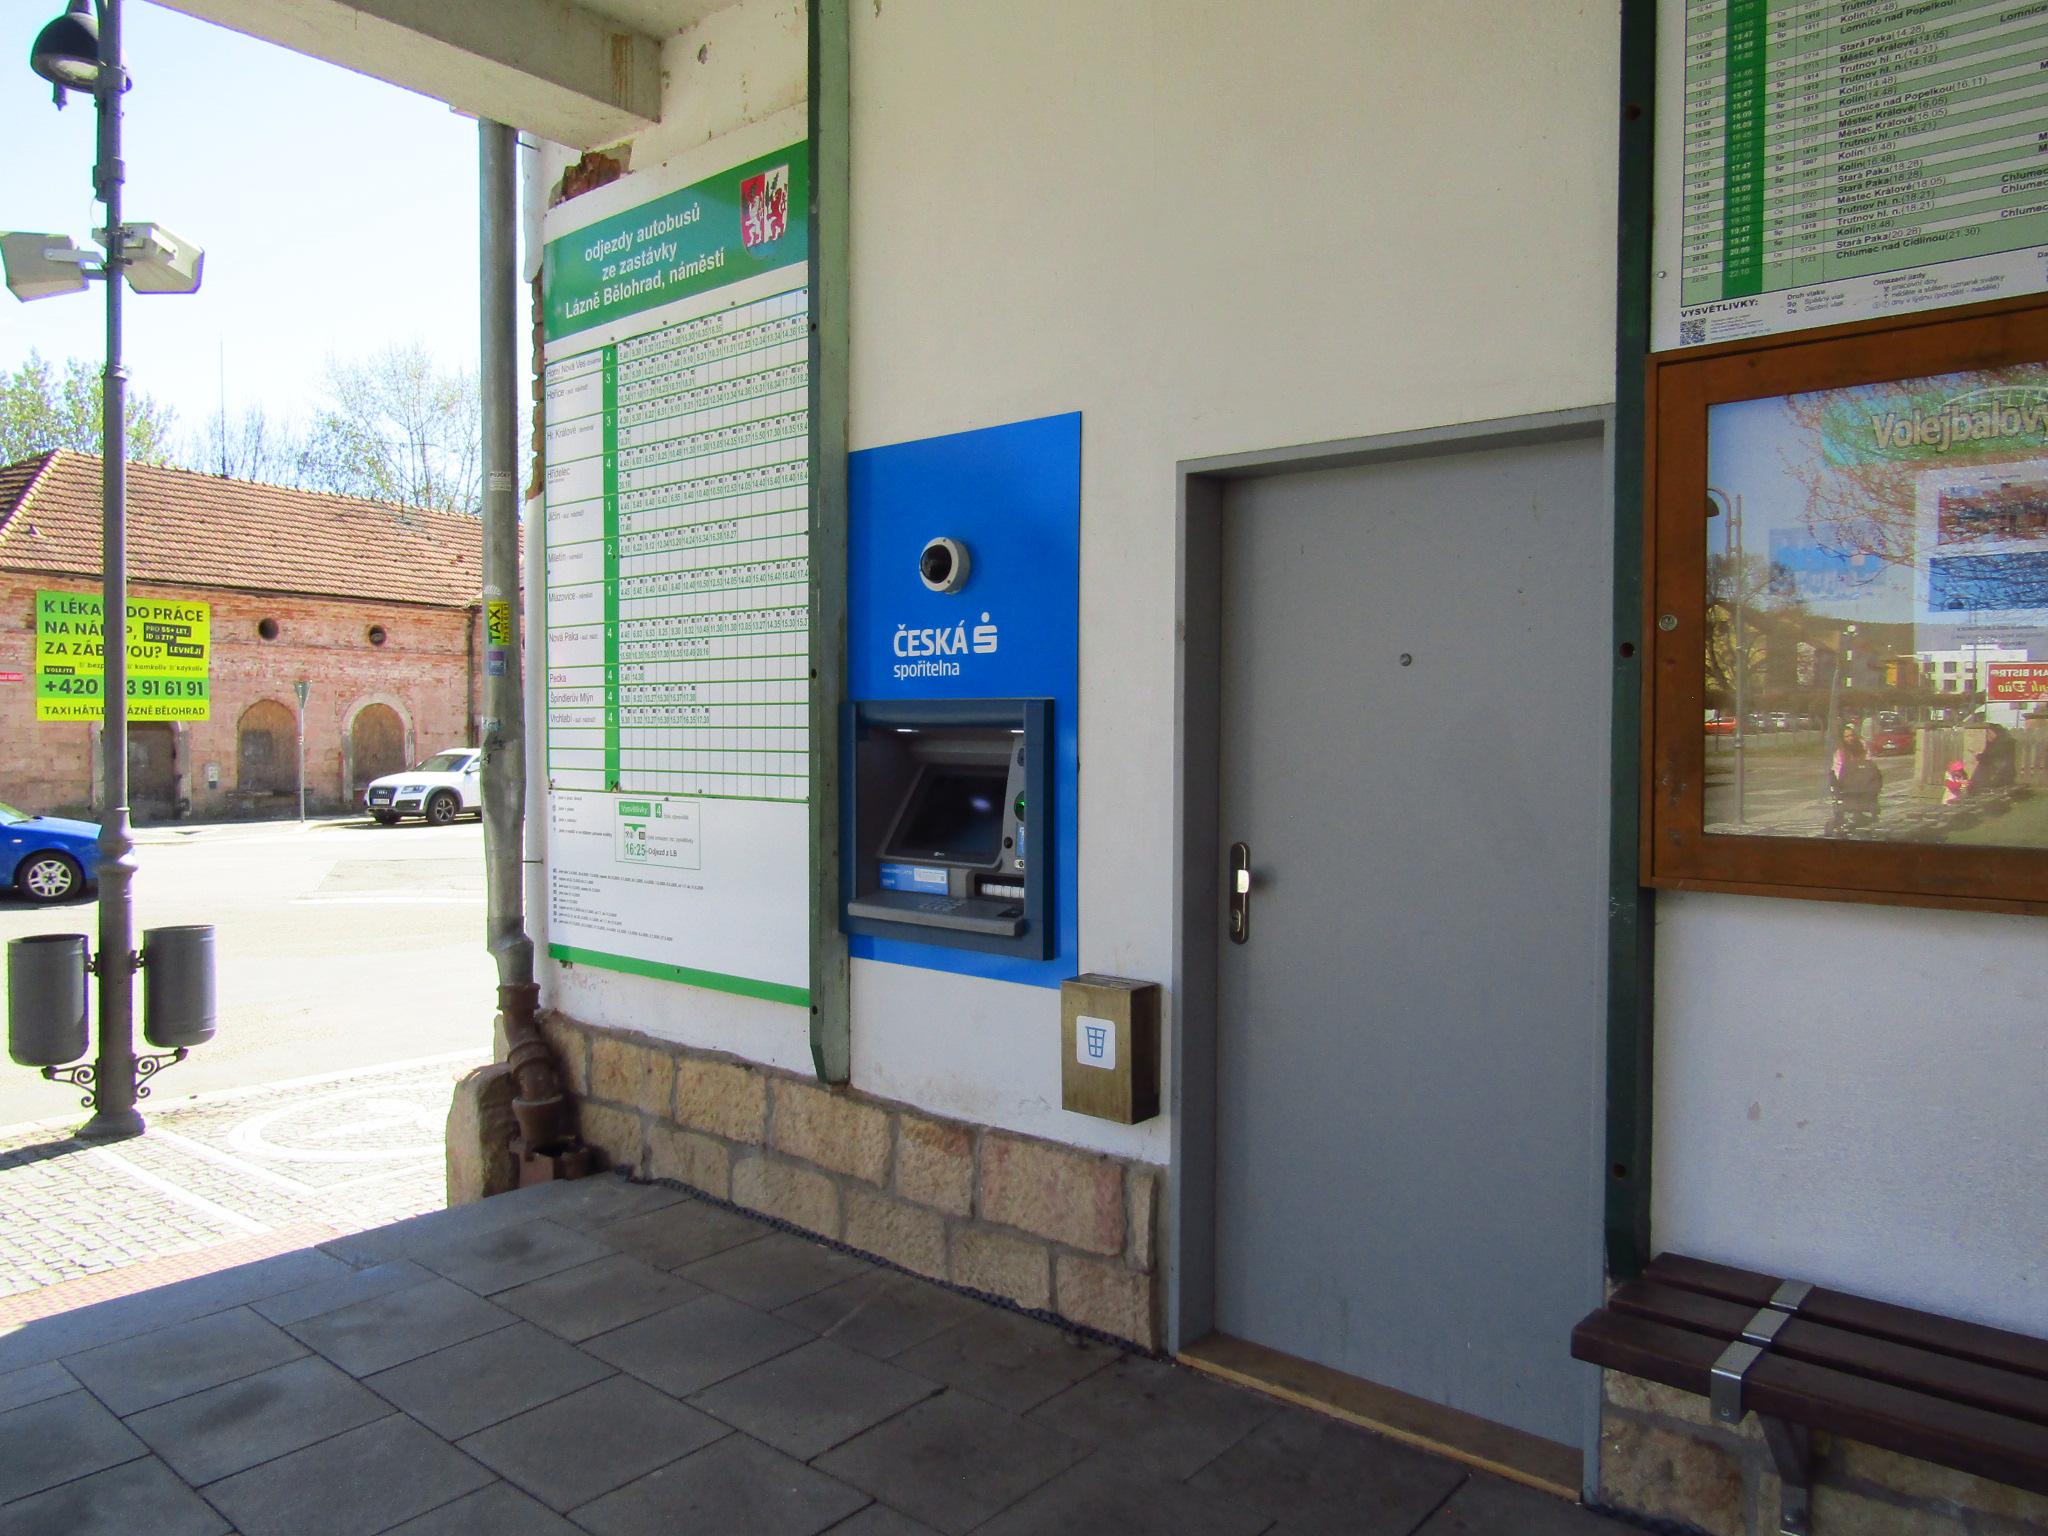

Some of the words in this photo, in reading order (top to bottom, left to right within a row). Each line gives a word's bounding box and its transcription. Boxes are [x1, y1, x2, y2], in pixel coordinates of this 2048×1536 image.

[1840, 18, 1882, 34] Lomnice
[1884, 12, 1903, 22] nad
[1840, 61, 1877, 74] Trutnov
[1840, 70, 1877, 85] Trutnov
[1839, 102, 1881, 118] Lomnice
[1883, 96, 1902, 106] nad
[1838, 134, 1875, 149] Trutnov
[1837, 202, 1875, 214] Trutnov
[1837, 213, 1874, 226] Trutnov
[585, 230, 634, 262] odjezdy
[636, 202, 700, 242] autobusů
[1836, 244, 1879, 259] Chlumec
[1881, 241, 1900, 252] nad
[602, 265, 616, 281] ze
[619, 241, 678, 275] zastávky
[566, 291, 600, 319] Lázně
[603, 270, 665, 305] Bělohrad,
[669, 247, 725, 283] náměstí
[1681, 298, 1759, 318] VYSVĚTLIVKY:
[606, 352, 610, 360] 4
[606, 375, 610, 384] 3
[606, 416, 611, 426] 3
[606, 459, 611, 469] 4
[608, 545, 612, 555] 2
[44, 600, 56, 613] K
[126, 606, 149, 618] DO
[154, 605, 204, 622] PRÁCE
[45, 621, 69, 634] NA
[489, 601, 501, 644] TAXI
[608, 628, 612, 638] 4
[893, 620, 969, 658] ČESKÁ
[45, 642, 67, 655] ZA
[608, 670, 612, 680] 4
[893, 659, 960, 681] spořitelna
[45, 679, 99, 694] +420
[142, 680, 159, 695] 91
[165, 681, 181, 696] 61
[187, 681, 203, 696] 91
[608, 692, 612, 702] 4
[44, 706, 70, 714] TAXI
[608, 712, 613, 722] 4
[656, 806, 661, 814] 4
[626, 843, 646, 856] 16:25
